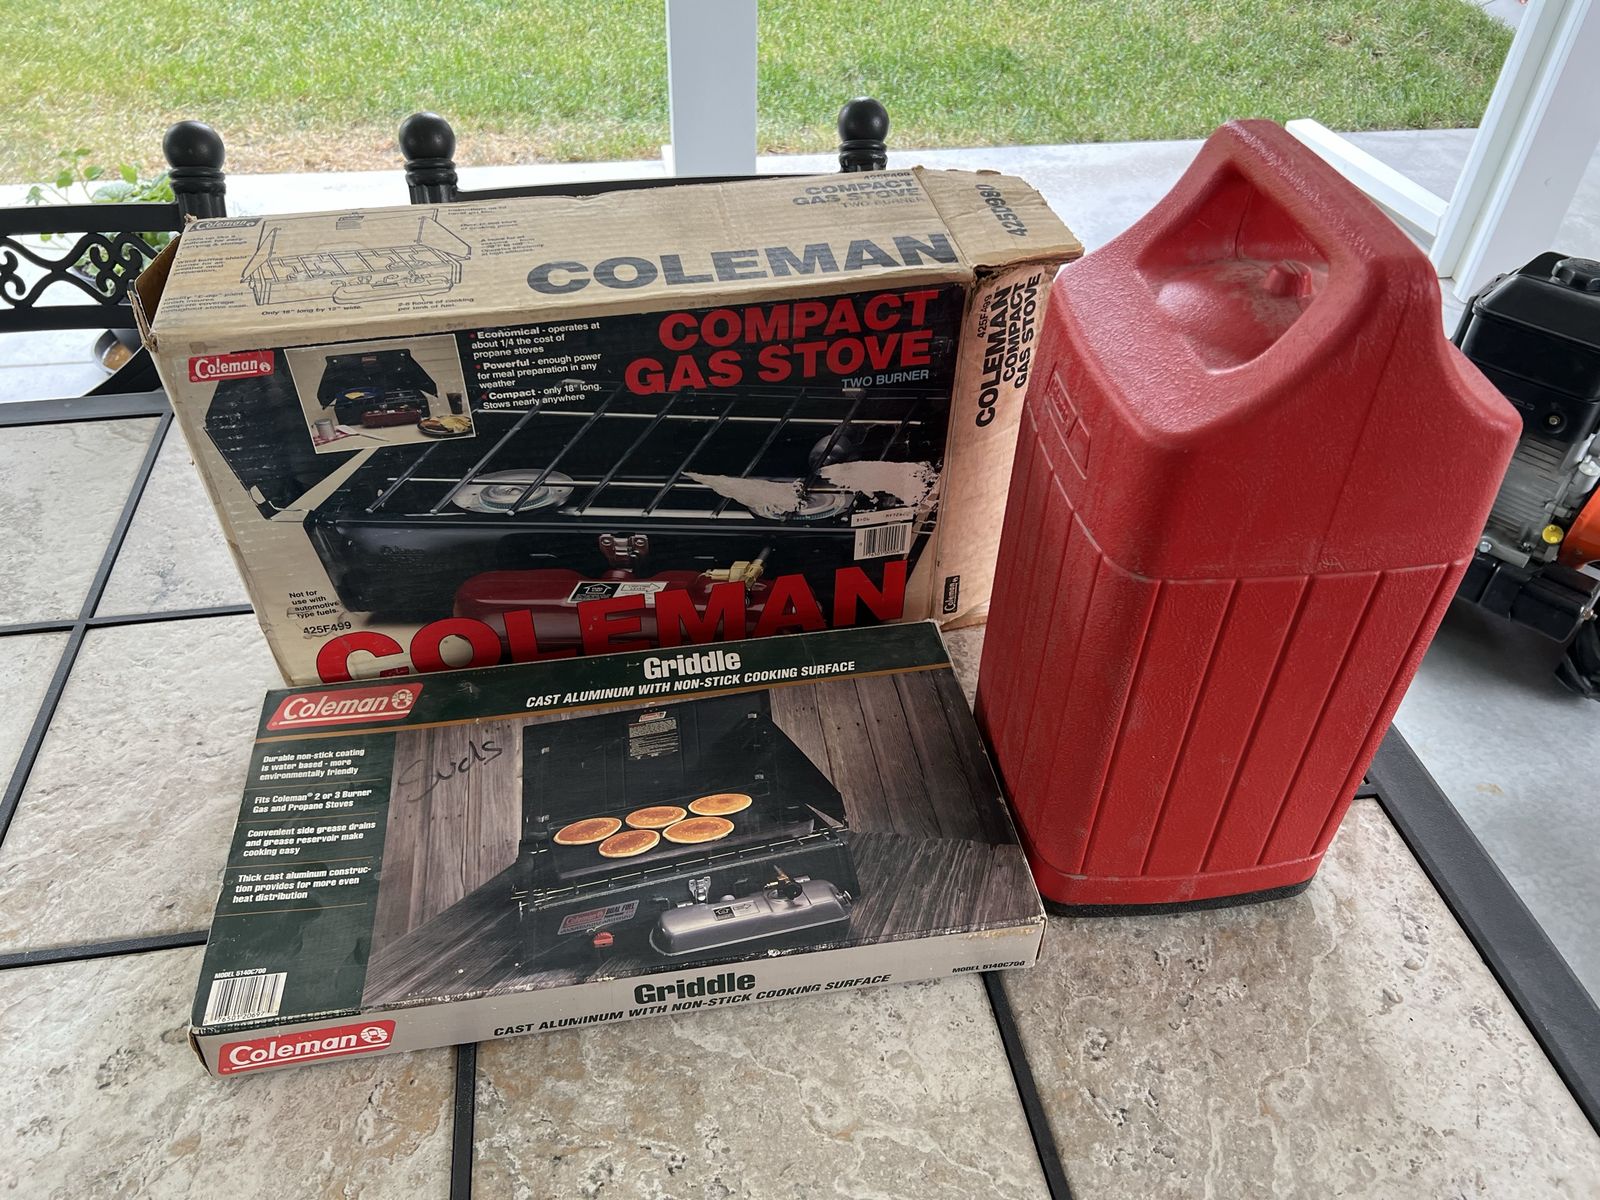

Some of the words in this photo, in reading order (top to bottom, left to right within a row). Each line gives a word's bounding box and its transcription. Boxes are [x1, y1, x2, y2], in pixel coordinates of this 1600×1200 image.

[805, 179, 913, 195] COMPACT
[793, 194, 841, 205] GAS
[847, 187, 920, 199] STOVE
[196, 219, 247, 230] Coleman
[527, 233, 958, 295] COLEMAN
[296, 306, 315, 314] long
[1022, 273, 1041, 342] STOVE
[658, 290, 939, 351] COMPACT
[477, 326, 540, 339] Economical
[547, 323, 589, 334] operates
[590, 322, 600, 330] at
[1003, 283, 1025, 382] COMPACT
[471, 340, 498, 350] about
[500, 338, 514, 348] 1/4
[516, 337, 531, 345] the
[533, 335, 554, 344] cost
[473, 350, 512, 360] propane
[513, 346, 544, 355] stoves
[483, 359, 529, 370] Powerful
[537, 355, 572, 366] enough
[574, 353, 602, 363] power
[976, 286, 1012, 427] COLEMAN
[195, 358, 257, 379] Coleman
[477, 372, 490, 380] for
[492, 370, 515, 379] meal
[517, 364, 569, 377] preparation
[570, 363, 579, 371] in
[580, 362, 598, 371] any
[624, 350, 743, 396] GAS
[757, 330, 933, 382] STOVE
[1014, 347, 1031, 389] GAS
[479, 379, 516, 389] weather
[842, 375, 872, 389] TWO
[876, 369, 929, 386] BURNER
[488, 389, 536, 401] Compact
[543, 385, 562, 396] only
[580, 381, 602, 392] long.
[483, 400, 511, 410] Stows
[512, 397, 540, 407] nearly
[542, 393, 586, 404] anywhere
[295, 601, 339, 611] automotive
[317, 608, 339, 616] fuels.
[303, 621, 352, 634] 425F499
[316, 560, 907, 683] COLEMAN
[643, 650, 741, 679] Griddle
[526, 695, 562, 708] CAST
[564, 686, 634, 703] ALUMINUM
[638, 682, 670, 695] WITH
[674, 674, 741, 691] NON-STICK
[744, 668, 798, 682] COOKING
[801, 661, 856, 677] SURFACE
[284, 695, 389, 720] Coleman
[263, 753, 295, 763] Durable
[297, 750, 333, 760] non-stick
[336, 749, 365, 757] coating
[260, 770, 325, 781] environmentally
[327, 767, 358, 776] friendly
[271, 762, 297, 770] water
[299, 761, 323, 769] based
[255, 796, 270, 804] Fits
[335, 791, 340, 799] 3
[343, 789, 372, 798] Burner
[253, 805, 269, 813] Gas
[271, 804, 286, 812] and
[288, 802, 323, 814] Propane
[326, 800, 354, 809] Stoves
[248, 828, 295, 838] Convenient
[297, 827, 314, 835] side
[317, 824, 347, 834] grease
[349, 822, 376, 830] drains
[245, 839, 261, 847] and
[263, 837, 294, 847] grease
[296, 834, 340, 844] reservoir
[341, 832, 364, 840] make
[243, 848, 277, 857] cooking
[279, 847, 300, 855] easy
[238, 874, 261, 882] Thick
[264, 873, 284, 881] cast
[286, 869, 327, 879] aluminum
[329, 866, 371, 877] construc-
[235, 884, 252, 893] tion
[254, 882, 294, 893] provides
[297, 880, 311, 889] for
[313, 879, 336, 887] more
[339, 877, 359, 885] even
[232, 895, 253, 903] heat
[255, 891, 308, 902] distribution
[952, 965, 980, 973] MODEL
[634, 972, 756, 1005] Griddle
[493, 1022, 535, 1036] CAST
[538, 1011, 624, 1031] ALUMINUM
[628, 1005, 668, 1018] WITH
[671, 994, 752, 1013] NON-STICK
[755, 983, 821, 1000] COOKING
[825, 973, 892, 991] SURFACE
[229, 1033, 357, 1066] Coleman
